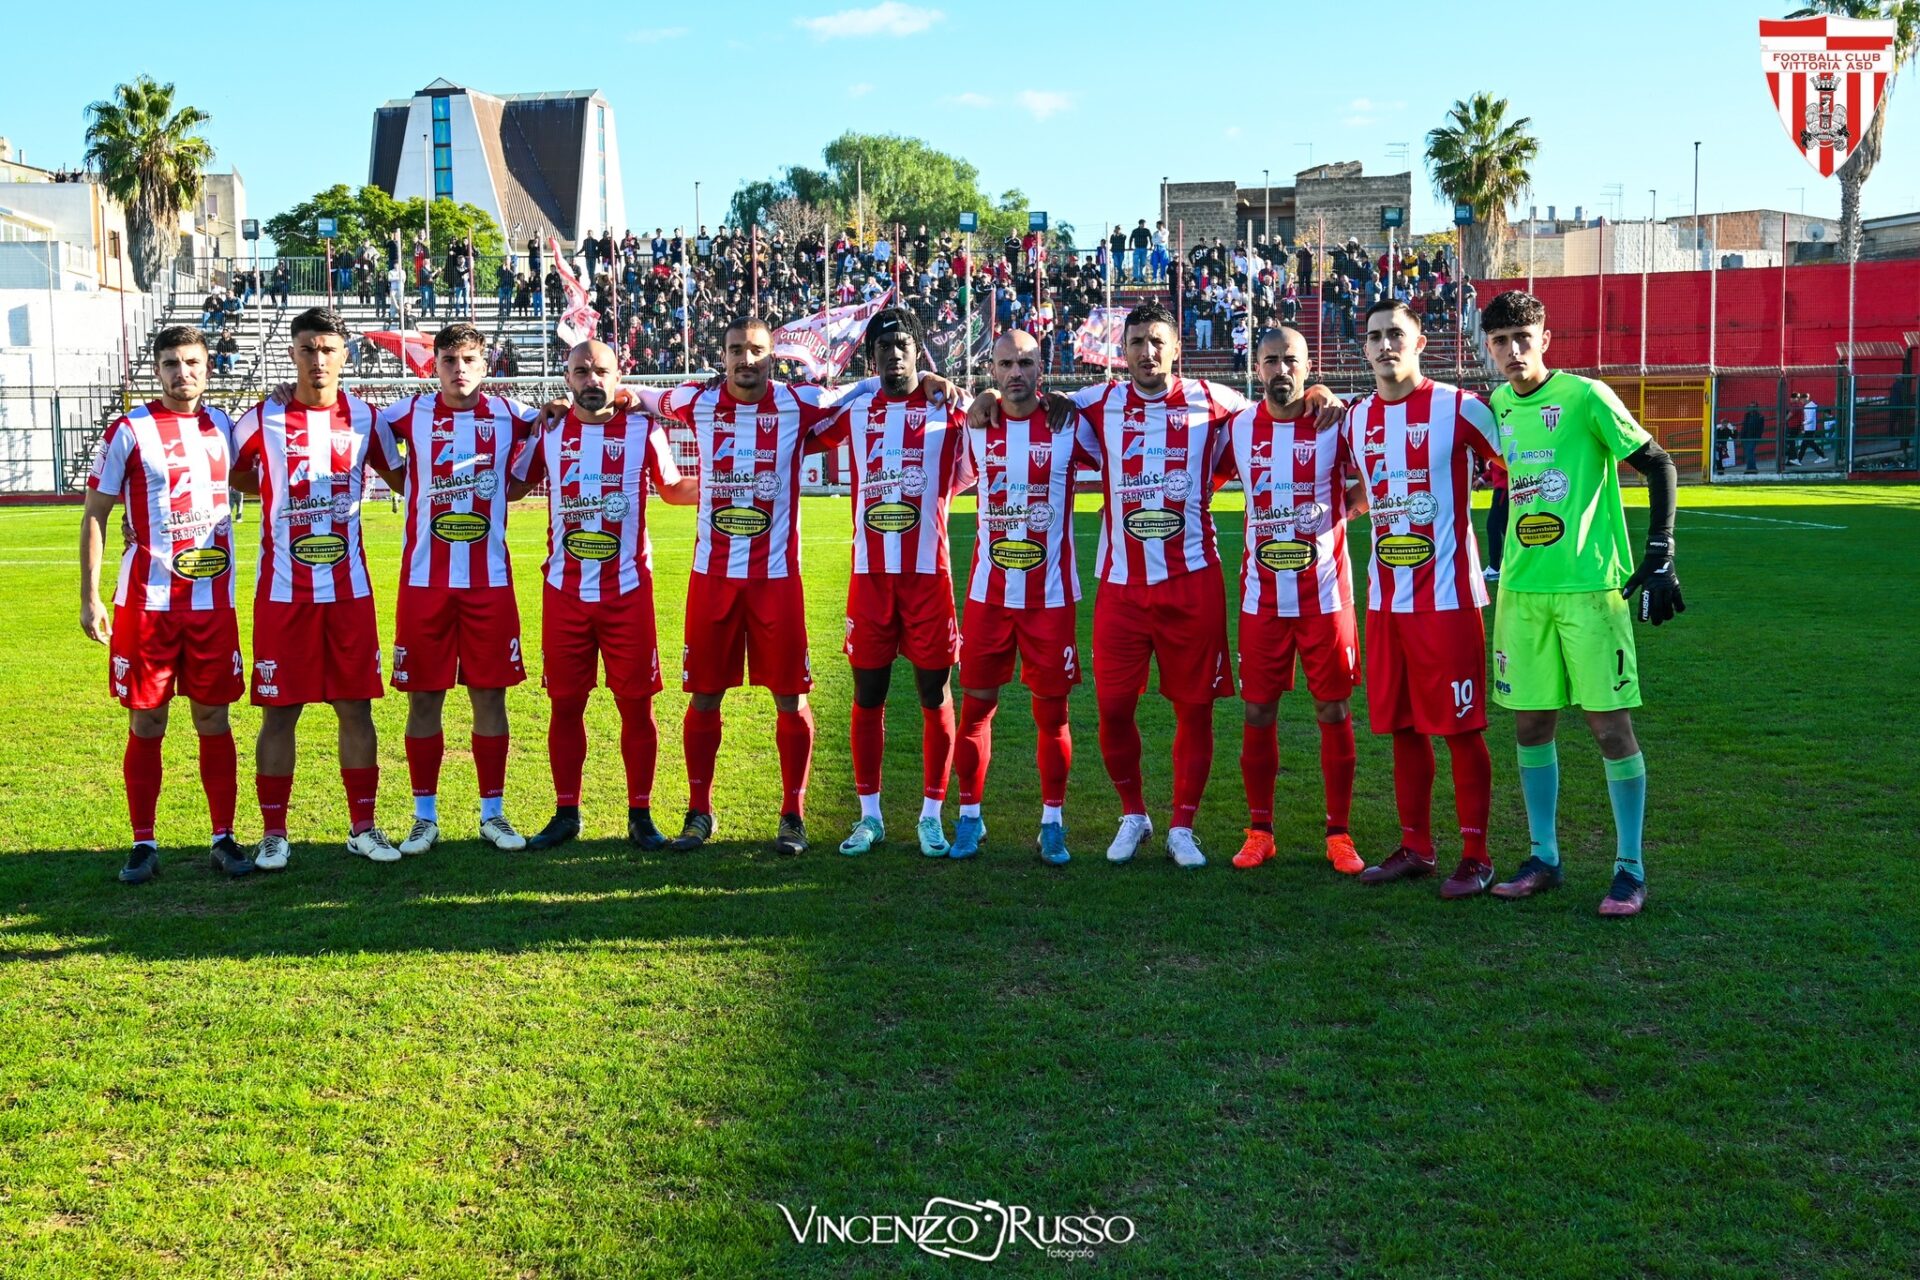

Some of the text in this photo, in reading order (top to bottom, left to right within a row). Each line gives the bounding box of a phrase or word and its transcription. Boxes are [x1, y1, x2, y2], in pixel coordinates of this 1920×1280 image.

[737, 449, 774, 458] AIRCON
[886, 448, 922, 458] AIRCON
[1146, 447, 1185, 456] AIRCON
[1521, 450, 1553, 459] AIRCON
[434, 472, 471, 489] Italo's
[583, 473, 620, 482] AIRCON
[714, 470, 750, 484] Italo's
[808, 469, 818, 483] 3
[866, 467, 896, 484] Italo's
[1123, 471, 1159, 487] Italo's
[1390, 469, 1425, 479] AIRCON
[1010, 483, 1047, 493] AIRCON
[1274, 482, 1312, 492] AIRCON
[289, 494, 326, 510] Italo's
[564, 493, 598, 509] Italo's
[1122, 491, 1156, 503] FARMER
[989, 502, 1022, 516] Italo's
[1256, 504, 1290, 521] Italo's
[1642, 590, 1650, 621] reusch
[509, 637, 520, 662] 2
[1616, 649, 1625, 676] 1
[1451, 679, 1473, 707] 10
